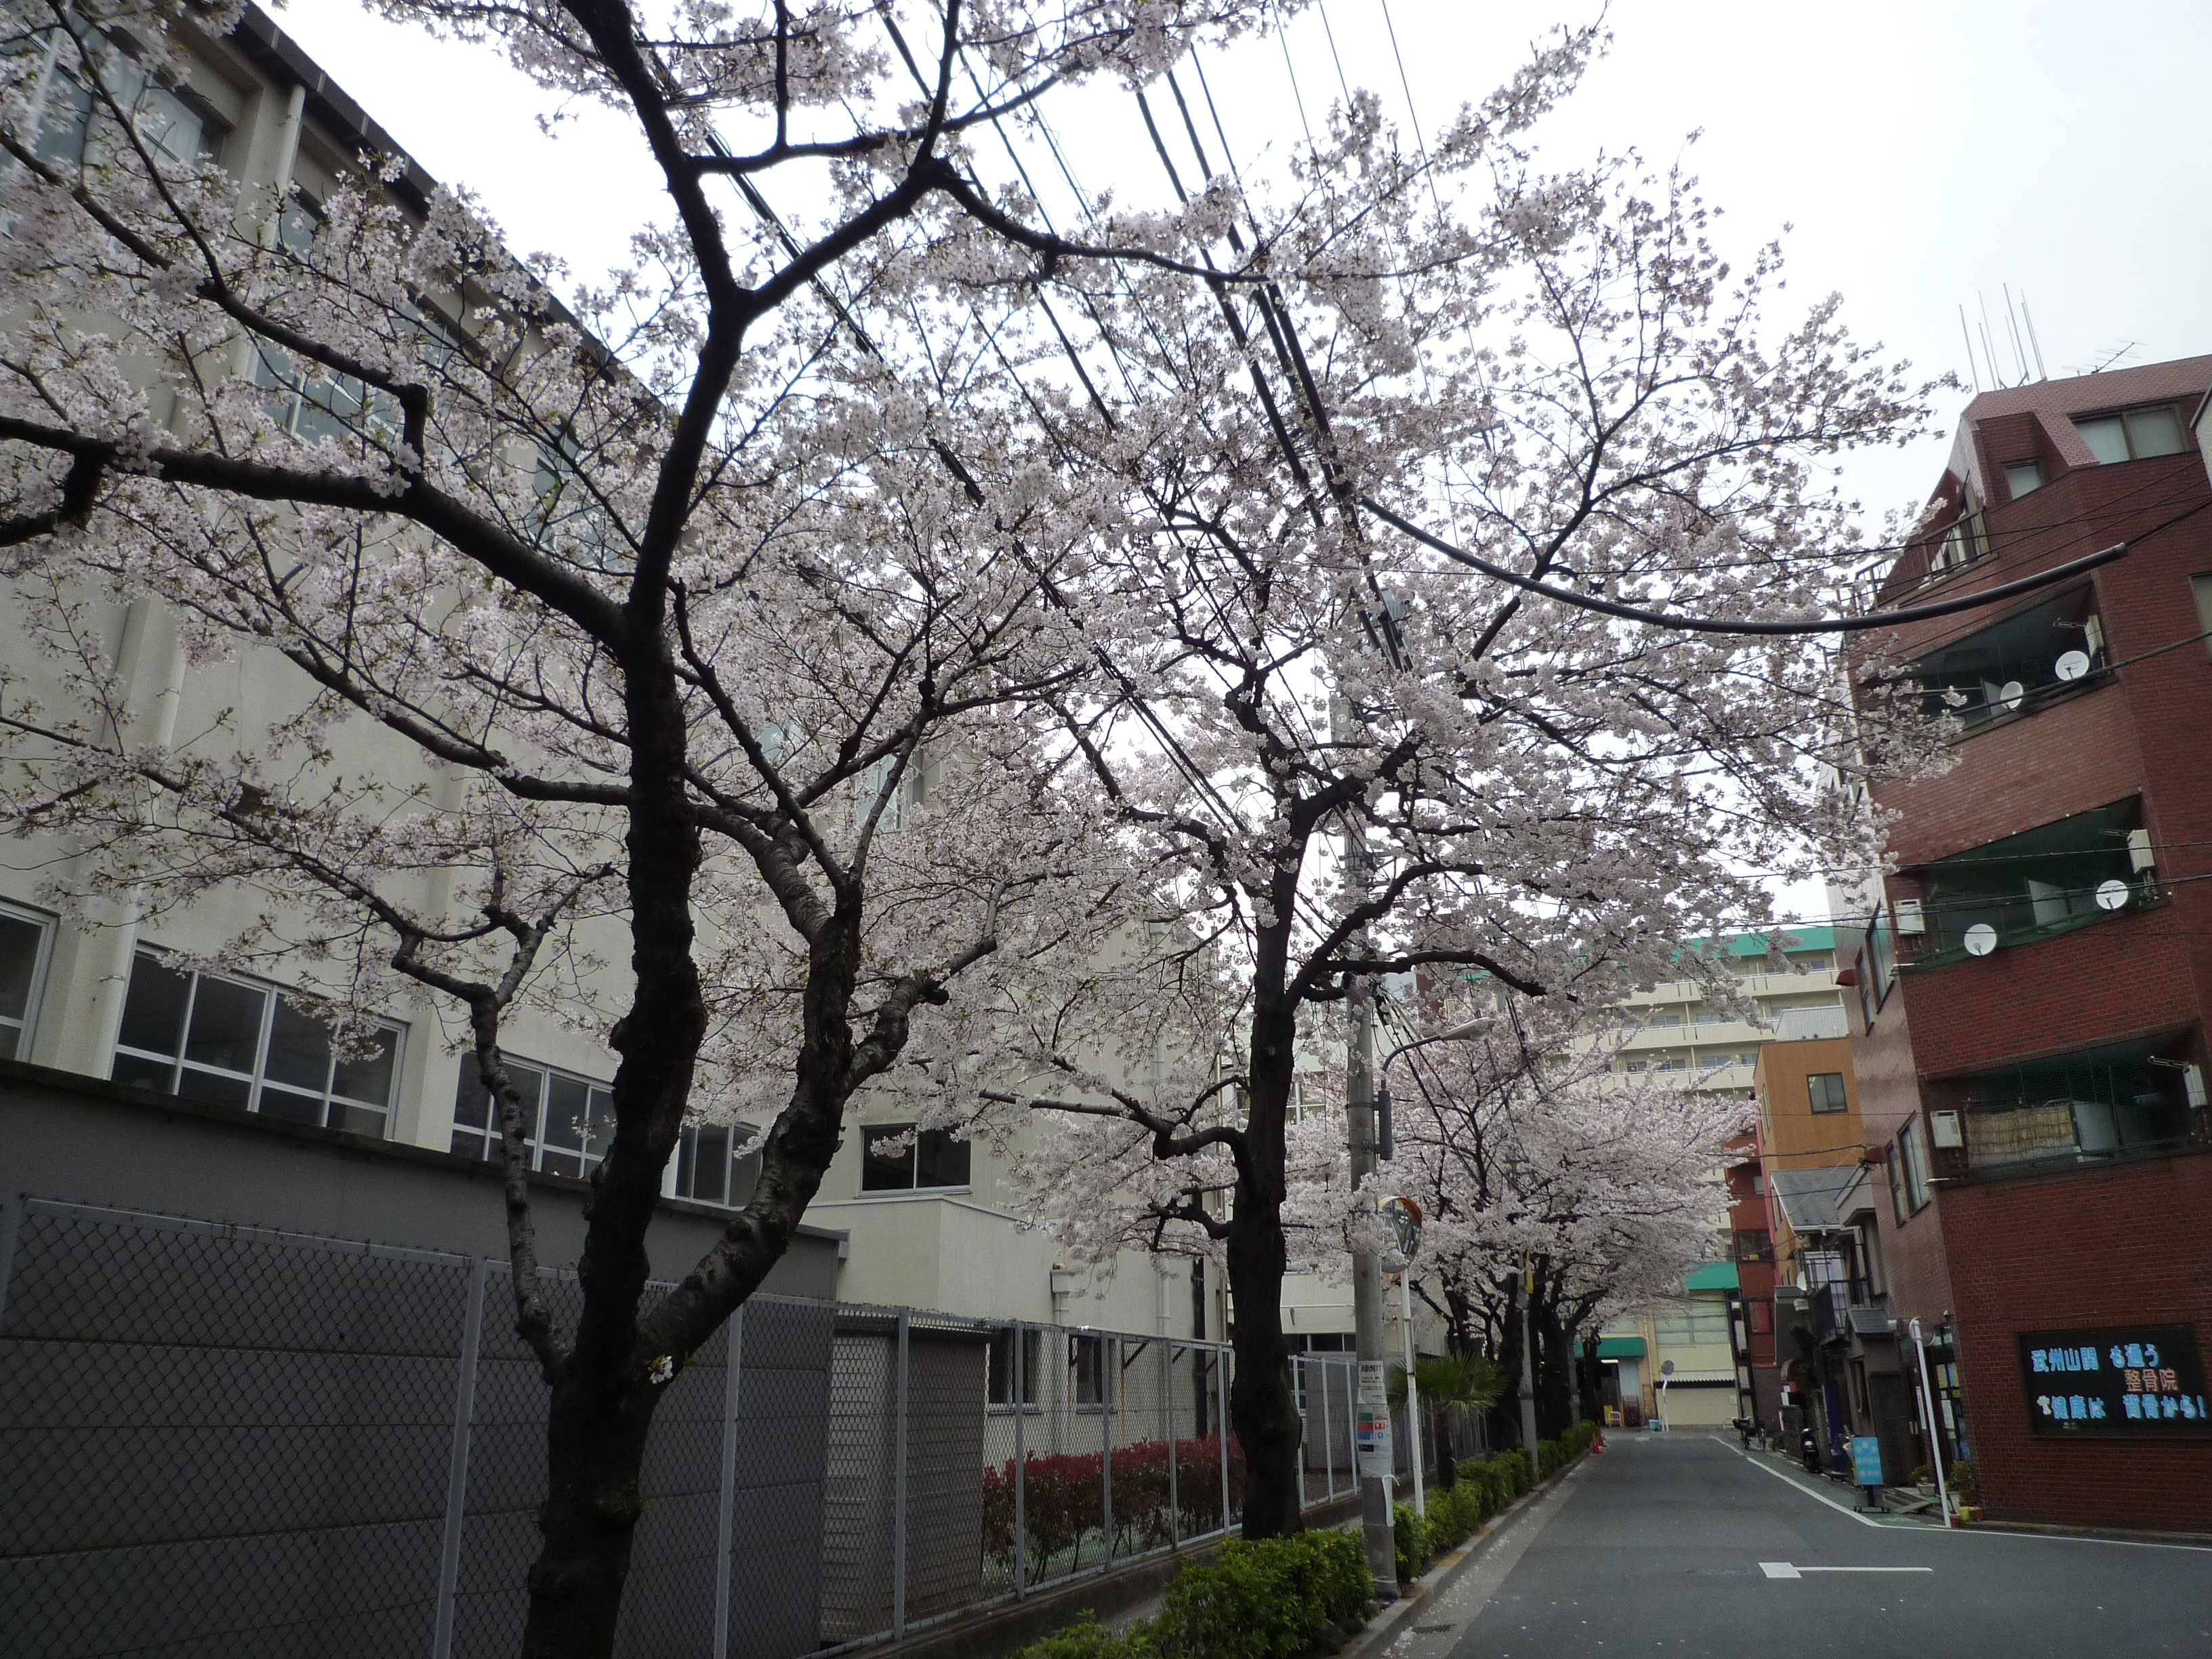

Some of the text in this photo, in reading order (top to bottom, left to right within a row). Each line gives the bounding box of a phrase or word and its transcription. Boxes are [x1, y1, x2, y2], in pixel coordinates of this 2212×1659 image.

[2123, 1368, 2179, 1393] 整骨院
[2051, 1395, 2106, 1420] 健康は
